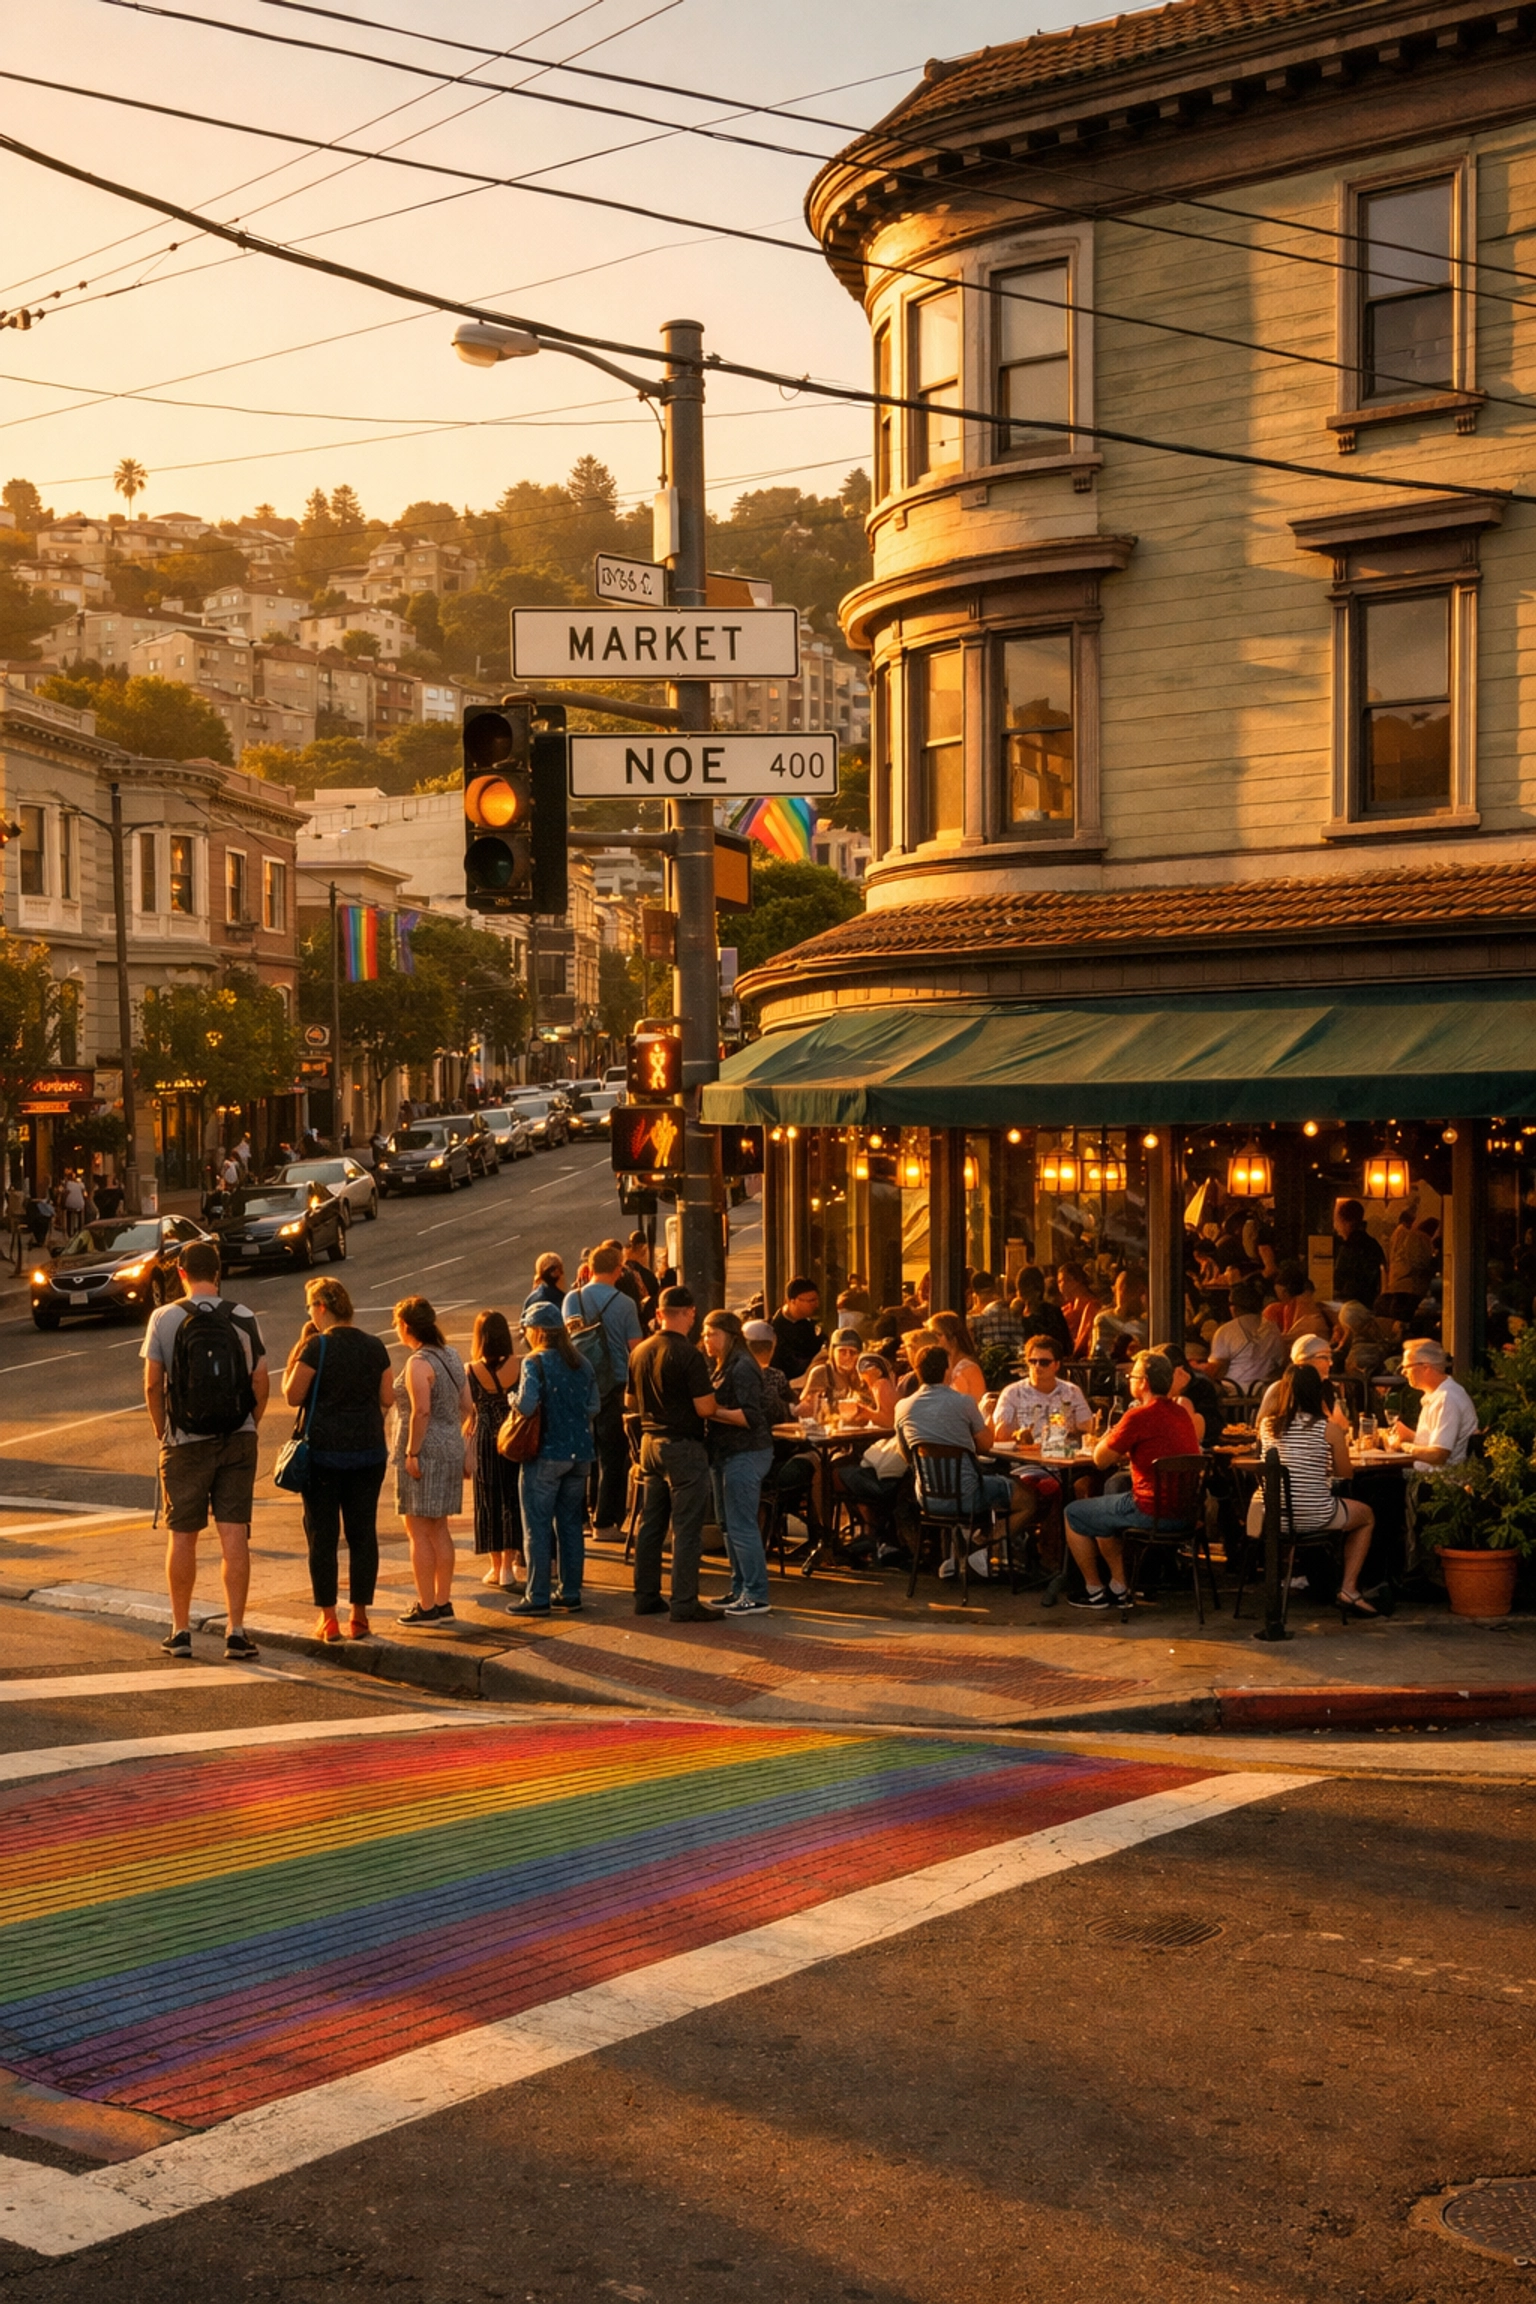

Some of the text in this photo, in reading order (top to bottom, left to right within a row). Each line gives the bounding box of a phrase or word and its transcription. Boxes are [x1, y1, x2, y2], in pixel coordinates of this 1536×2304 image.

[569, 626, 742, 661] MARKET
[625, 746, 825, 785] NOE 400
